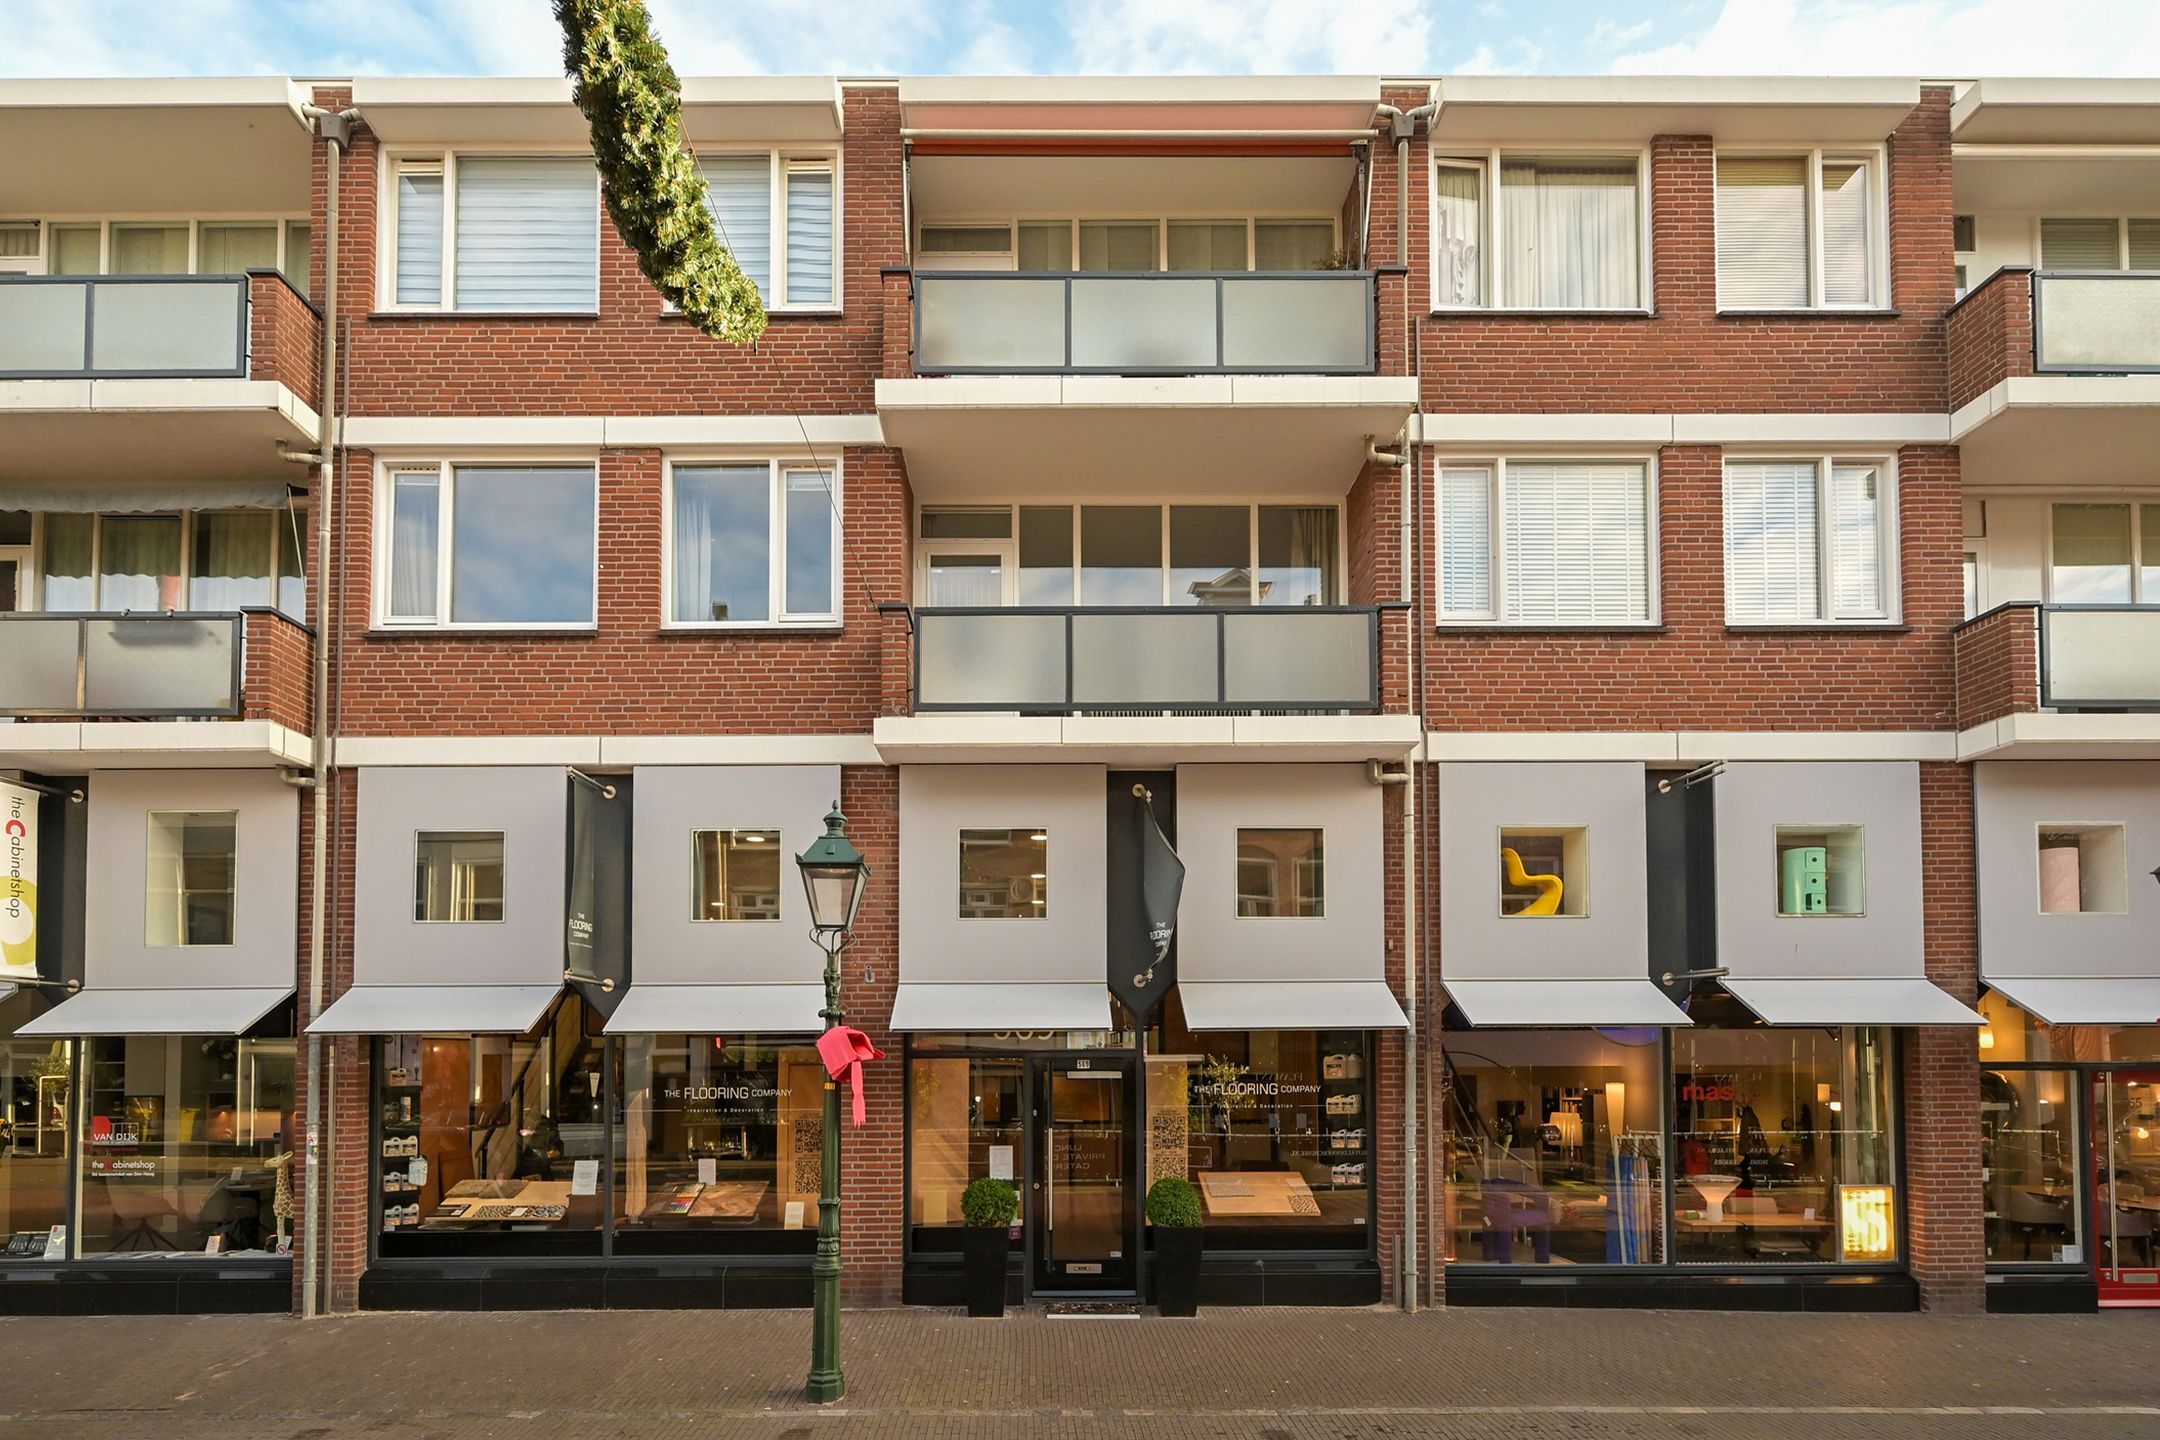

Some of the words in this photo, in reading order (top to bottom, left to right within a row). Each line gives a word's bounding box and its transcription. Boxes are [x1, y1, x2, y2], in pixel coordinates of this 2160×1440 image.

[664, 1089, 681, 1098] THE
[683, 1086, 749, 1099] FLOORING
[751, 1088, 793, 1097] COMPANY
[1193, 1085, 1211, 1094] THE
[1213, 1082, 1279, 1095] FLOORING
[1280, 1084, 1322, 1094] COMPANY
[93, 1132, 113, 1141] VAN
[116, 1132, 138, 1141] DIJK
